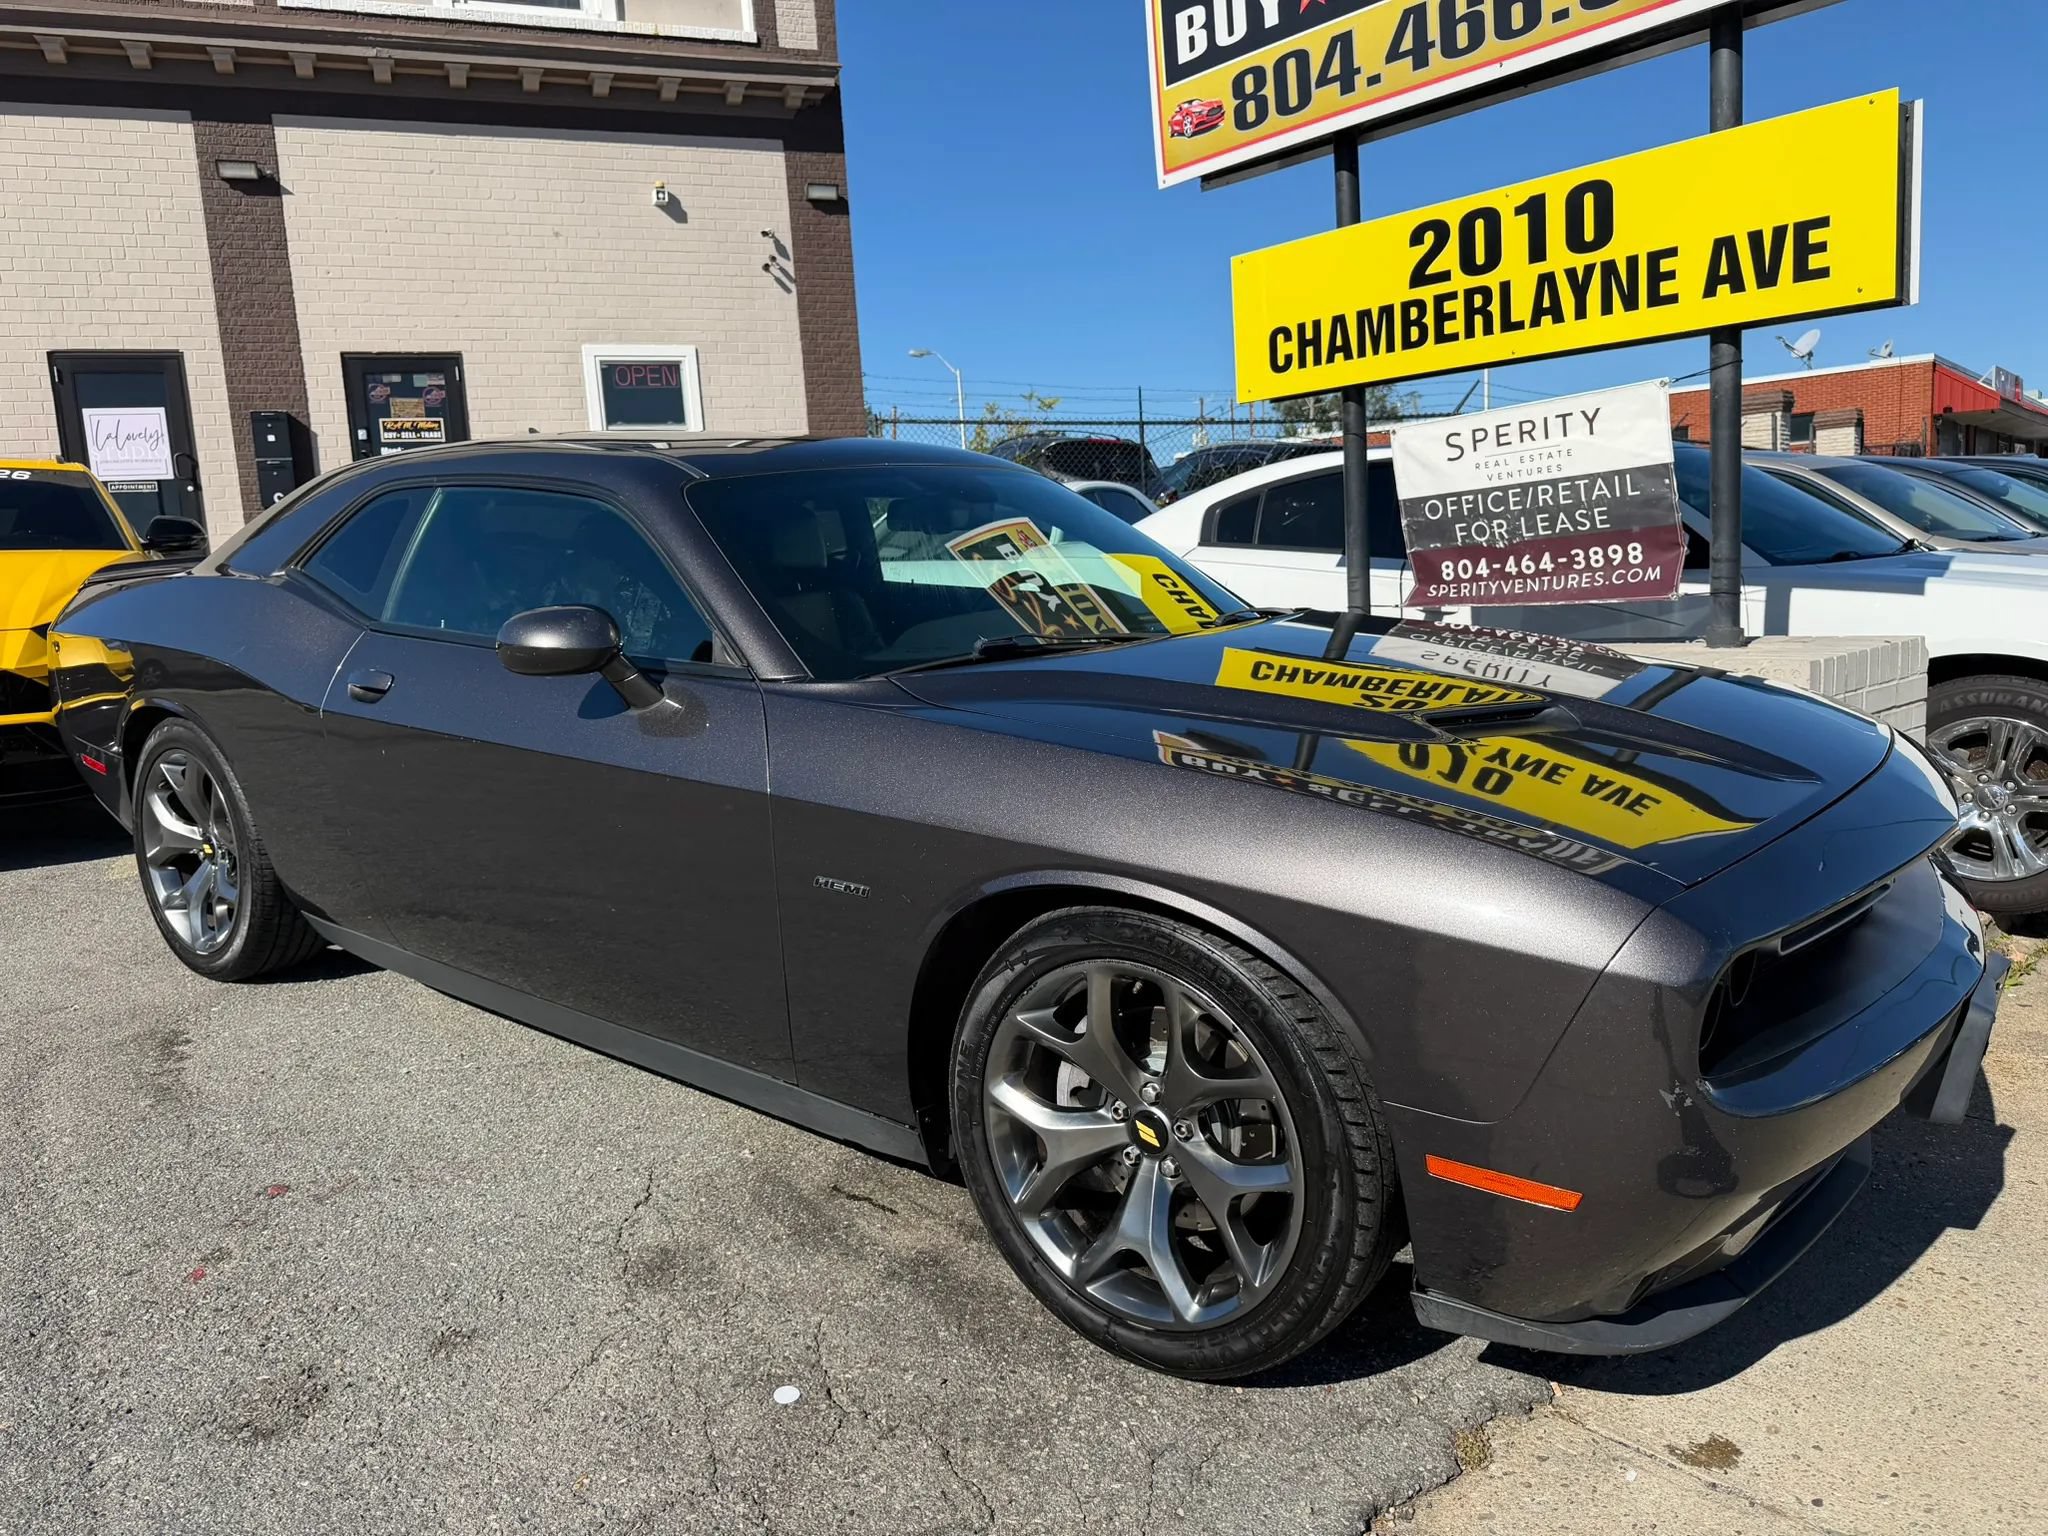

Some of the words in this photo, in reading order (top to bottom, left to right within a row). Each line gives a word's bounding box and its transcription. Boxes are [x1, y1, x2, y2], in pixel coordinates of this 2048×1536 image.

[1175, 0, 1280, 65] BUY
[1232, 0, 1619, 131] 804.466.
[1409, 180, 1614, 289] 2010
[1269, 247, 1679, 374] CHAMBERLAYNE
[1703, 216, 1831, 299] AVE
[615, 365, 677, 386] OPEN
[1445, 407, 1602, 462] SPERITY
[1475, 458, 1510, 470] REAL
[1519, 449, 1573, 464] ESTATE
[1486, 464, 1563, 481] VENTURES
[1424, 474, 1641, 520] OFFICE/RETAIL
[1455, 519, 1508, 543] FOR
[1521, 507, 1611, 538] LEASE
[1440, 542, 1644, 581] 804-464-3898
[1426, 565, 1662, 598] SPERITYVENTURES.COM
[1940, 691, 2048, 714] ASSURAN
[813, 875, 870, 898] HEMI
